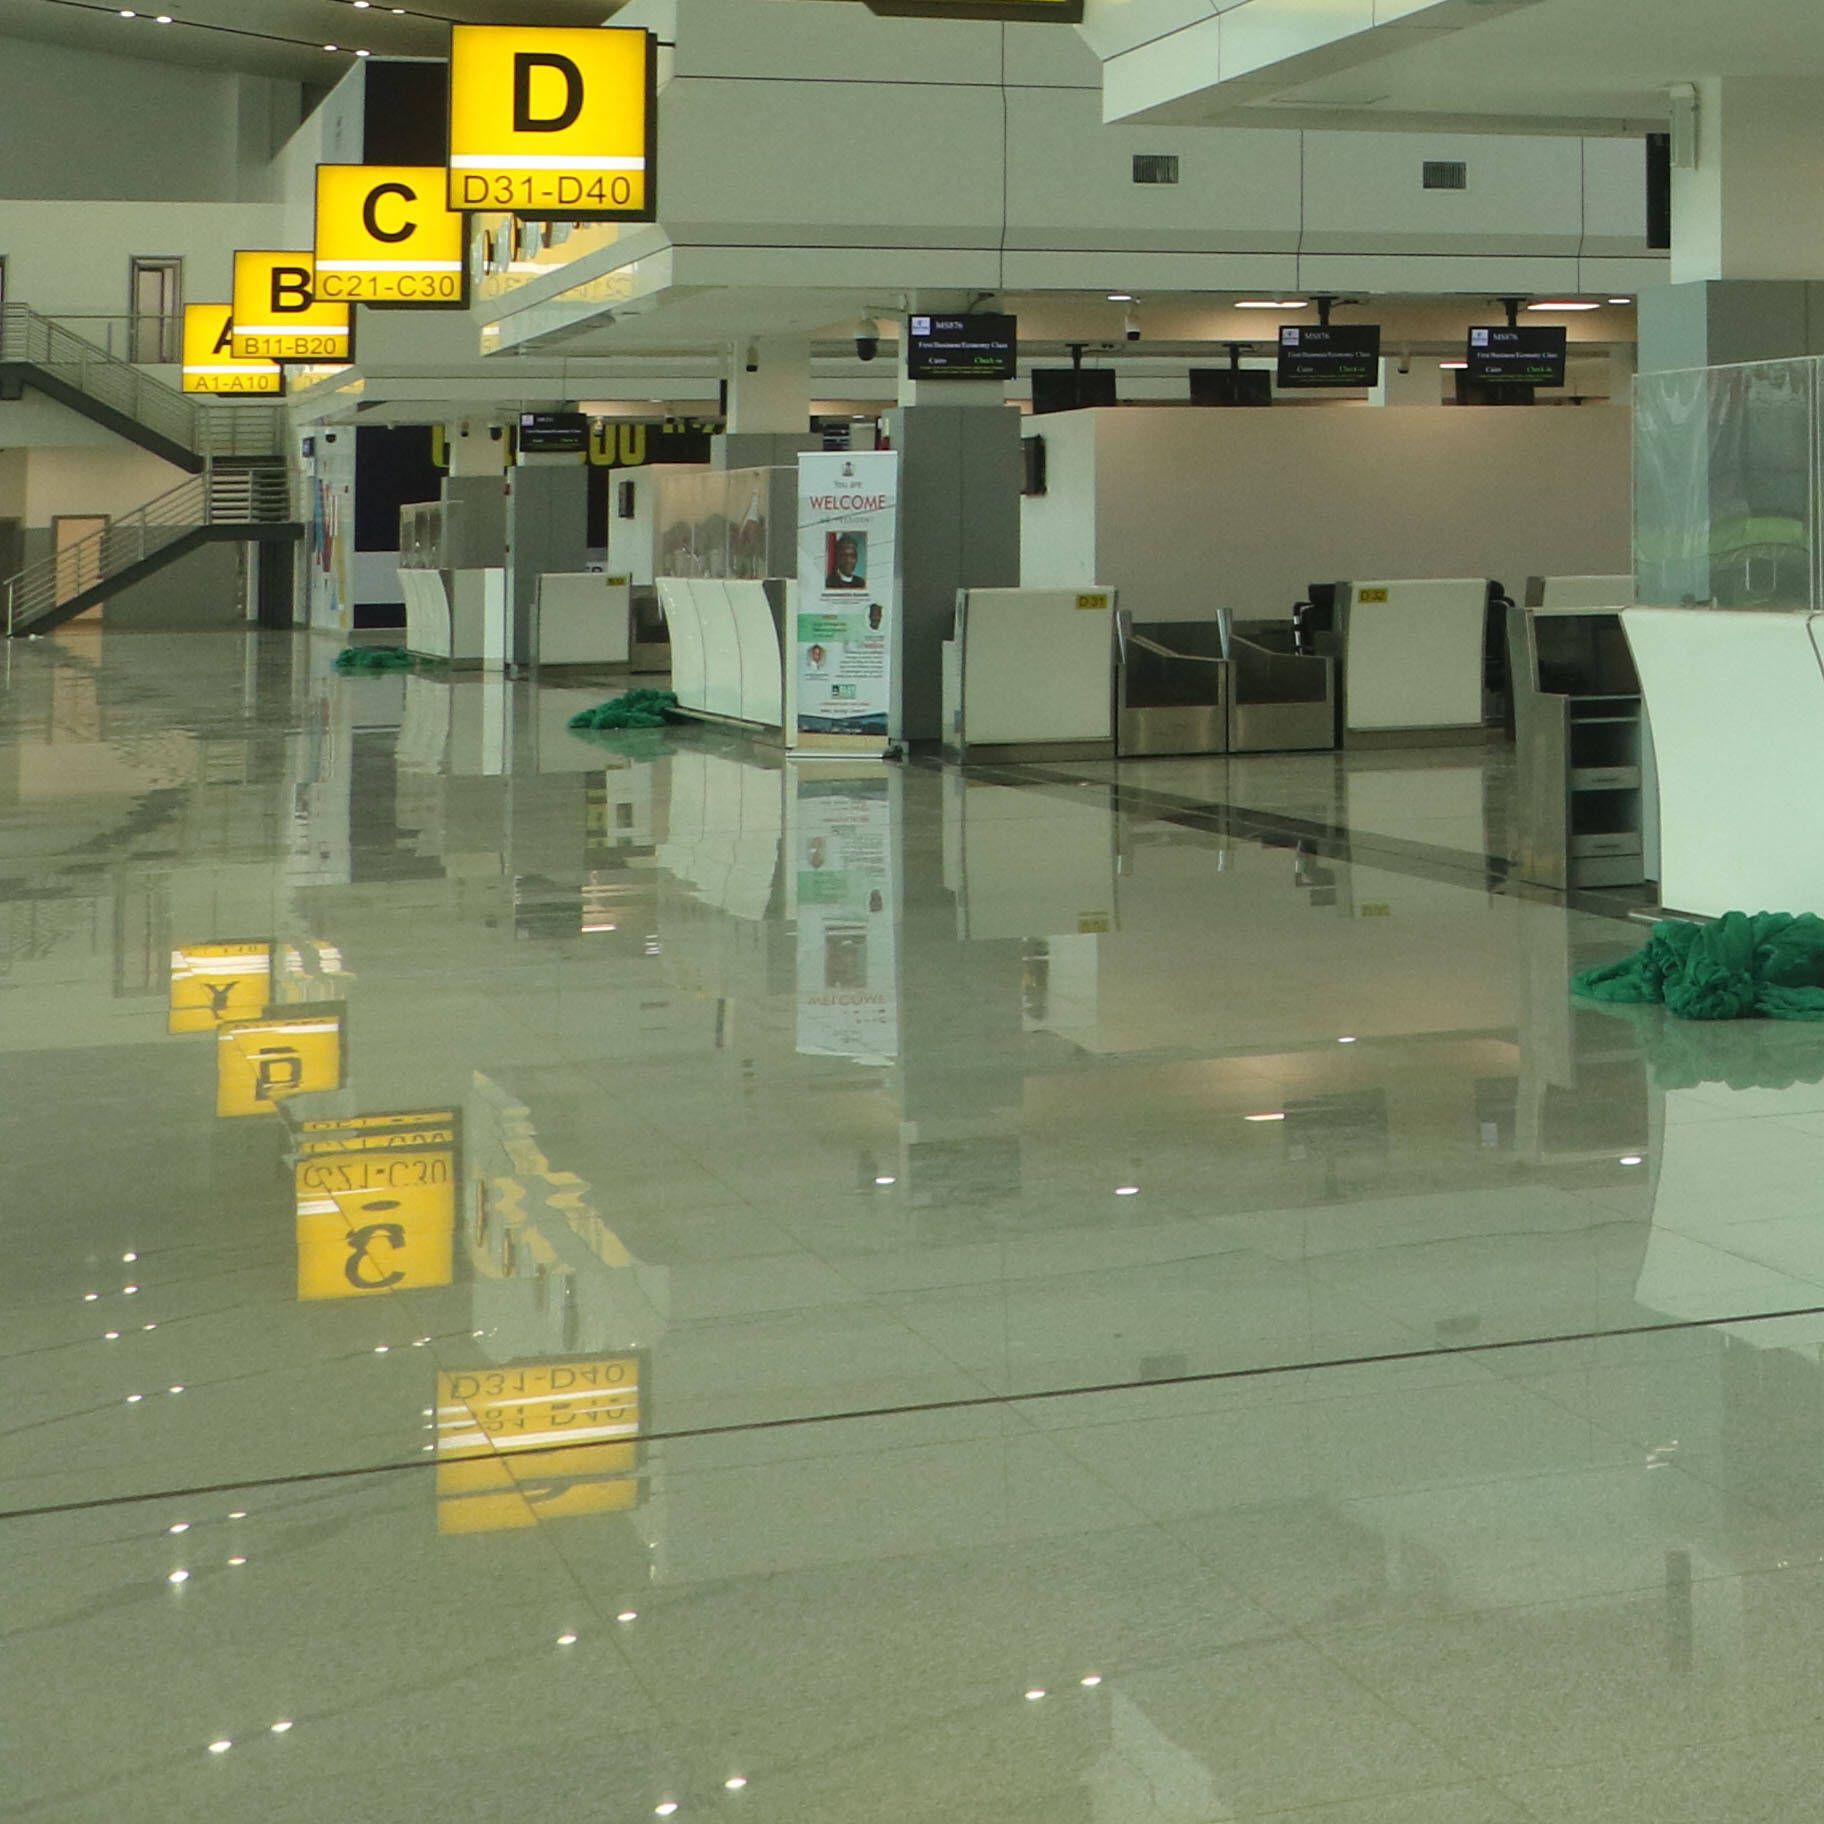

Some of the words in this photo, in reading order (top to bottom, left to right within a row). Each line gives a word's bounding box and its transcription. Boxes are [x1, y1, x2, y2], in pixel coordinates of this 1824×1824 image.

[513, 52, 584, 133] D
[463, 175, 631, 205] D31-D40
[362, 183, 418, 243] C
[270, 267, 315, 313] B
[322, 275, 456, 298] C21-C30
[244, 338, 337, 356] B11-B20
[194, 376, 269, 391] A1-A10
[809, 494, 886, 511] WELCOME
